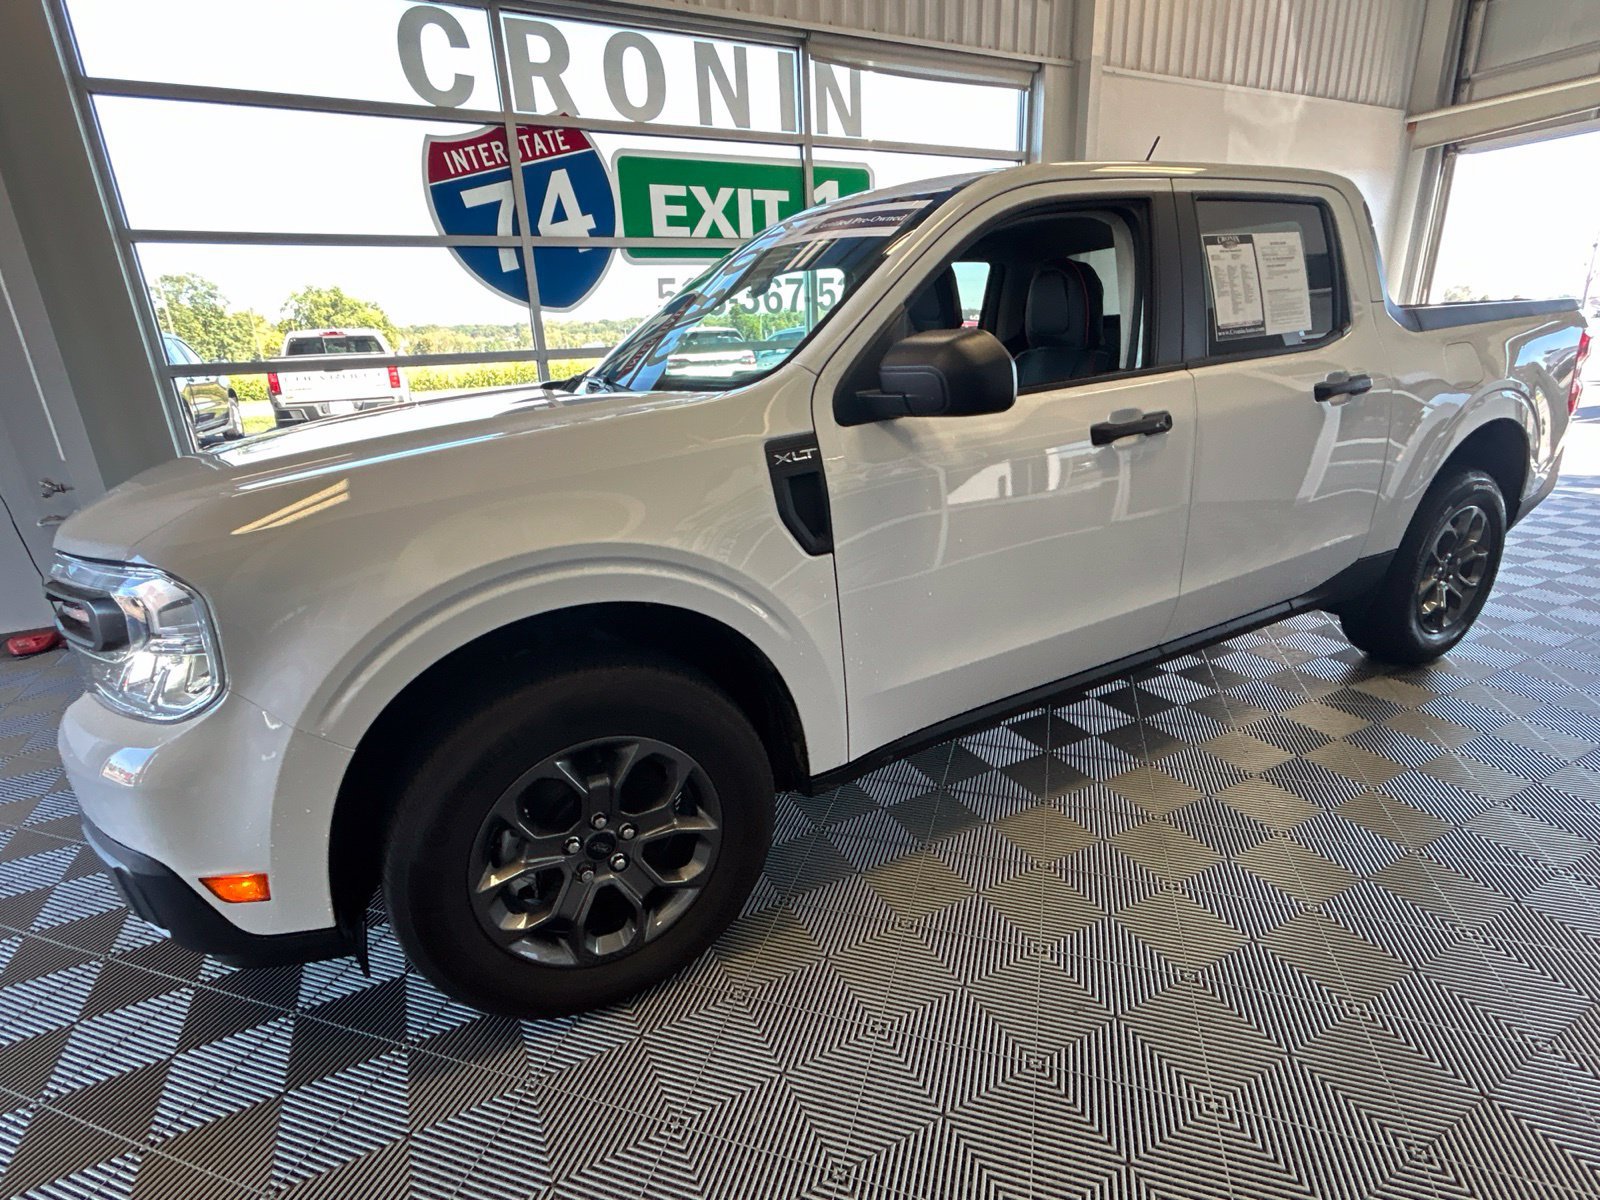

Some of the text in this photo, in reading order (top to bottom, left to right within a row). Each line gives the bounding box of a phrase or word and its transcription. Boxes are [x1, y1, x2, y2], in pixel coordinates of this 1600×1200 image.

[397, 5, 862, 137] CRONIN
[443, 128, 570, 175] INTERTATE
[459, 168, 597, 273] 74
[649, 183, 790, 239] EXIT
[773, 447, 818, 465] XLT
